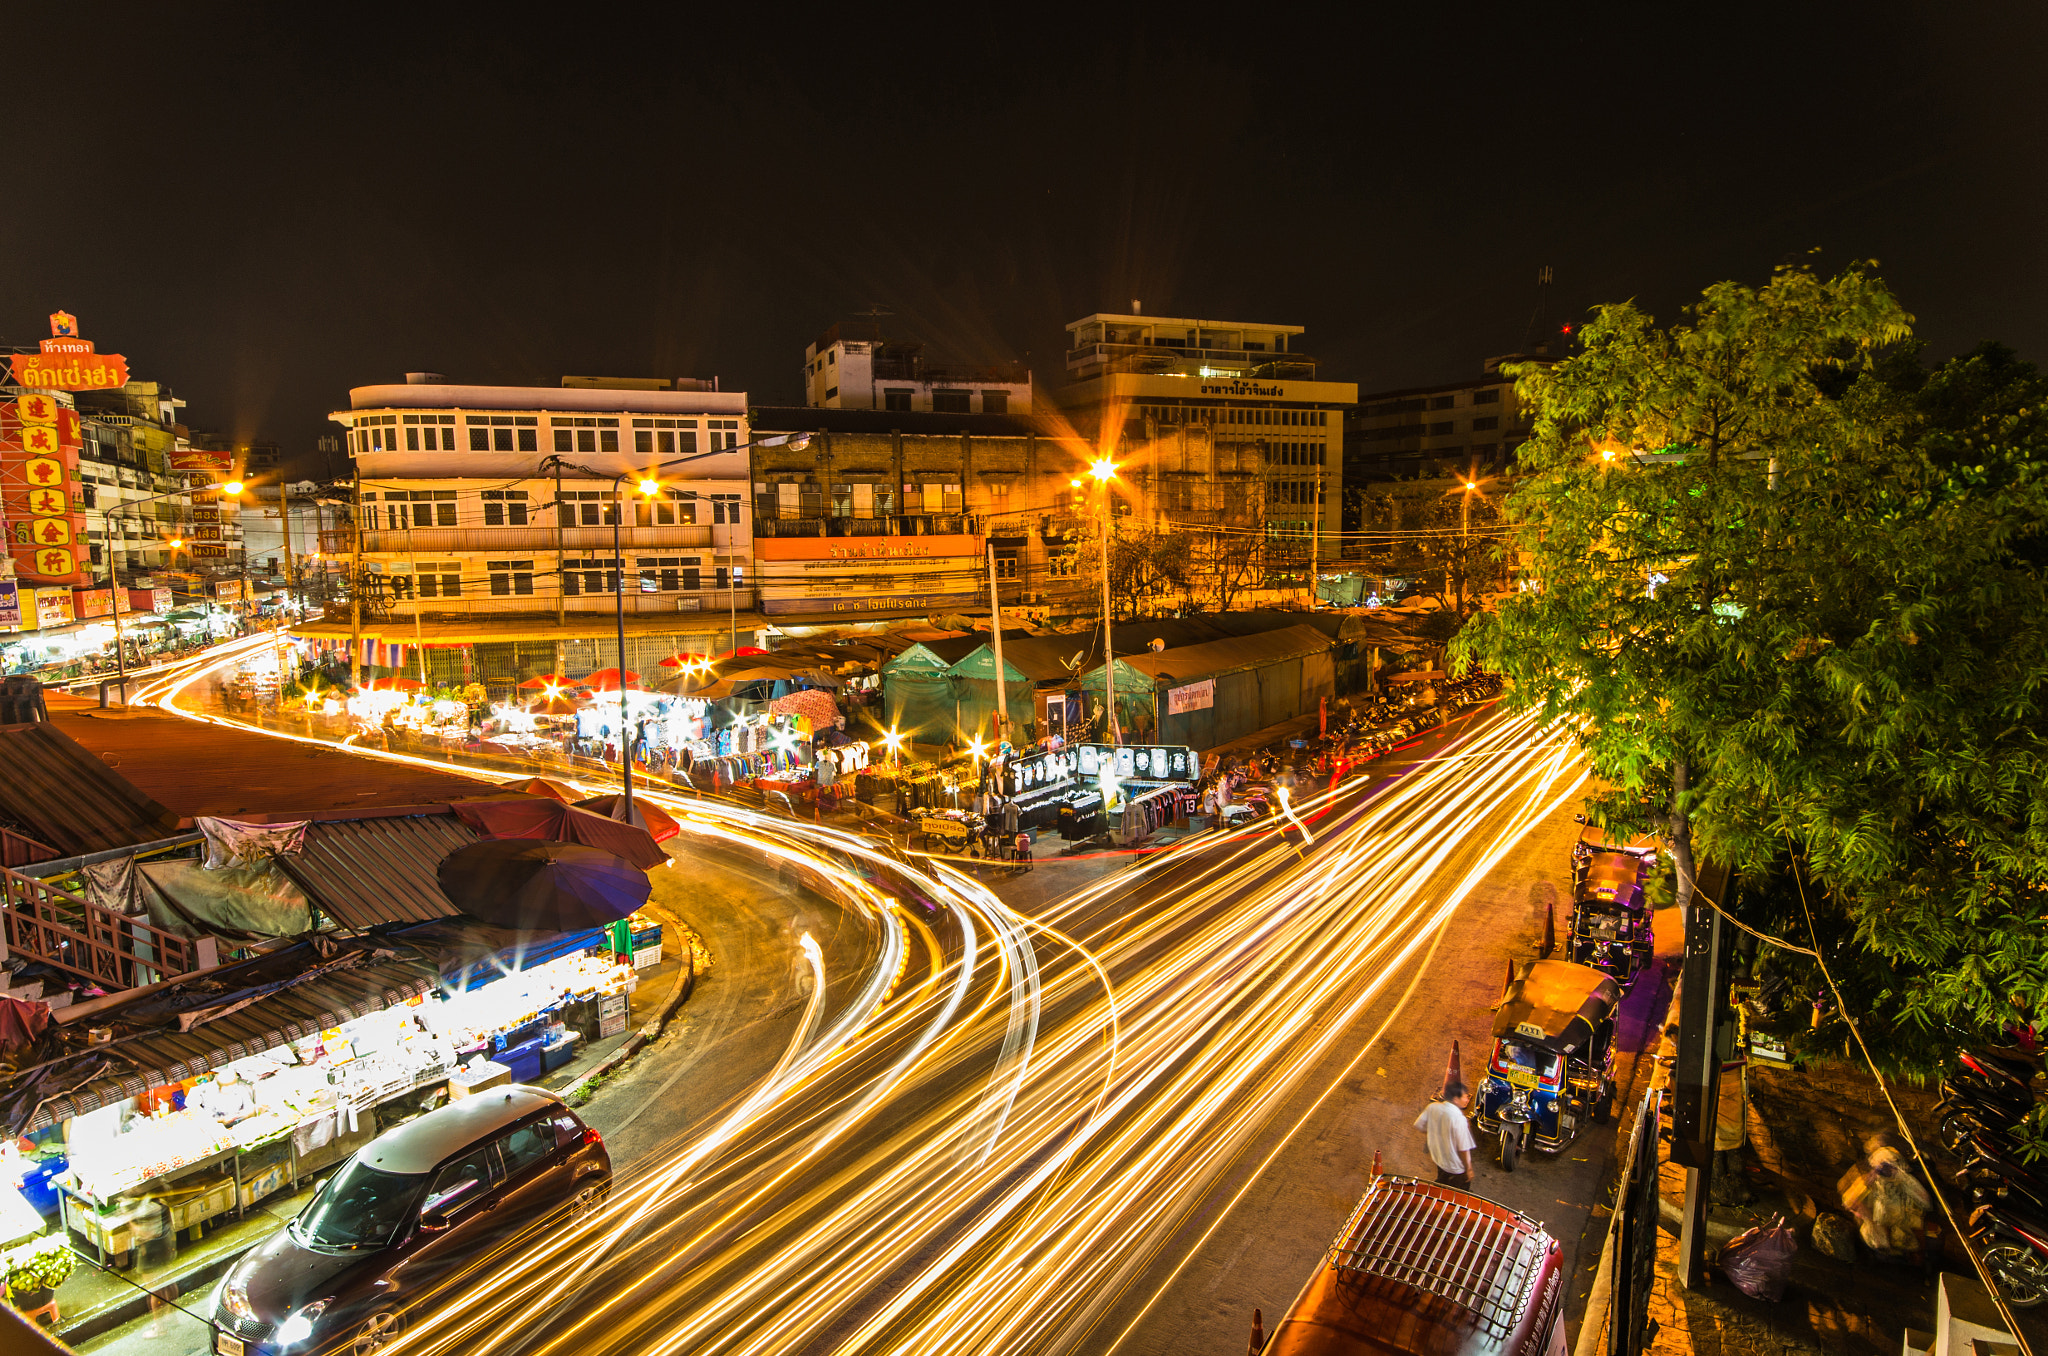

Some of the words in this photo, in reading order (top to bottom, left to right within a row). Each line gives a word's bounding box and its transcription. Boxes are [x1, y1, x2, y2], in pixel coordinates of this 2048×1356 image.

[44, 340, 90, 353] ห้างทอง
[194, 510, 219, 520] ทอง
[1185, 799, 1196, 813] 13
[1519, 1024, 1540, 1036] TAXI
